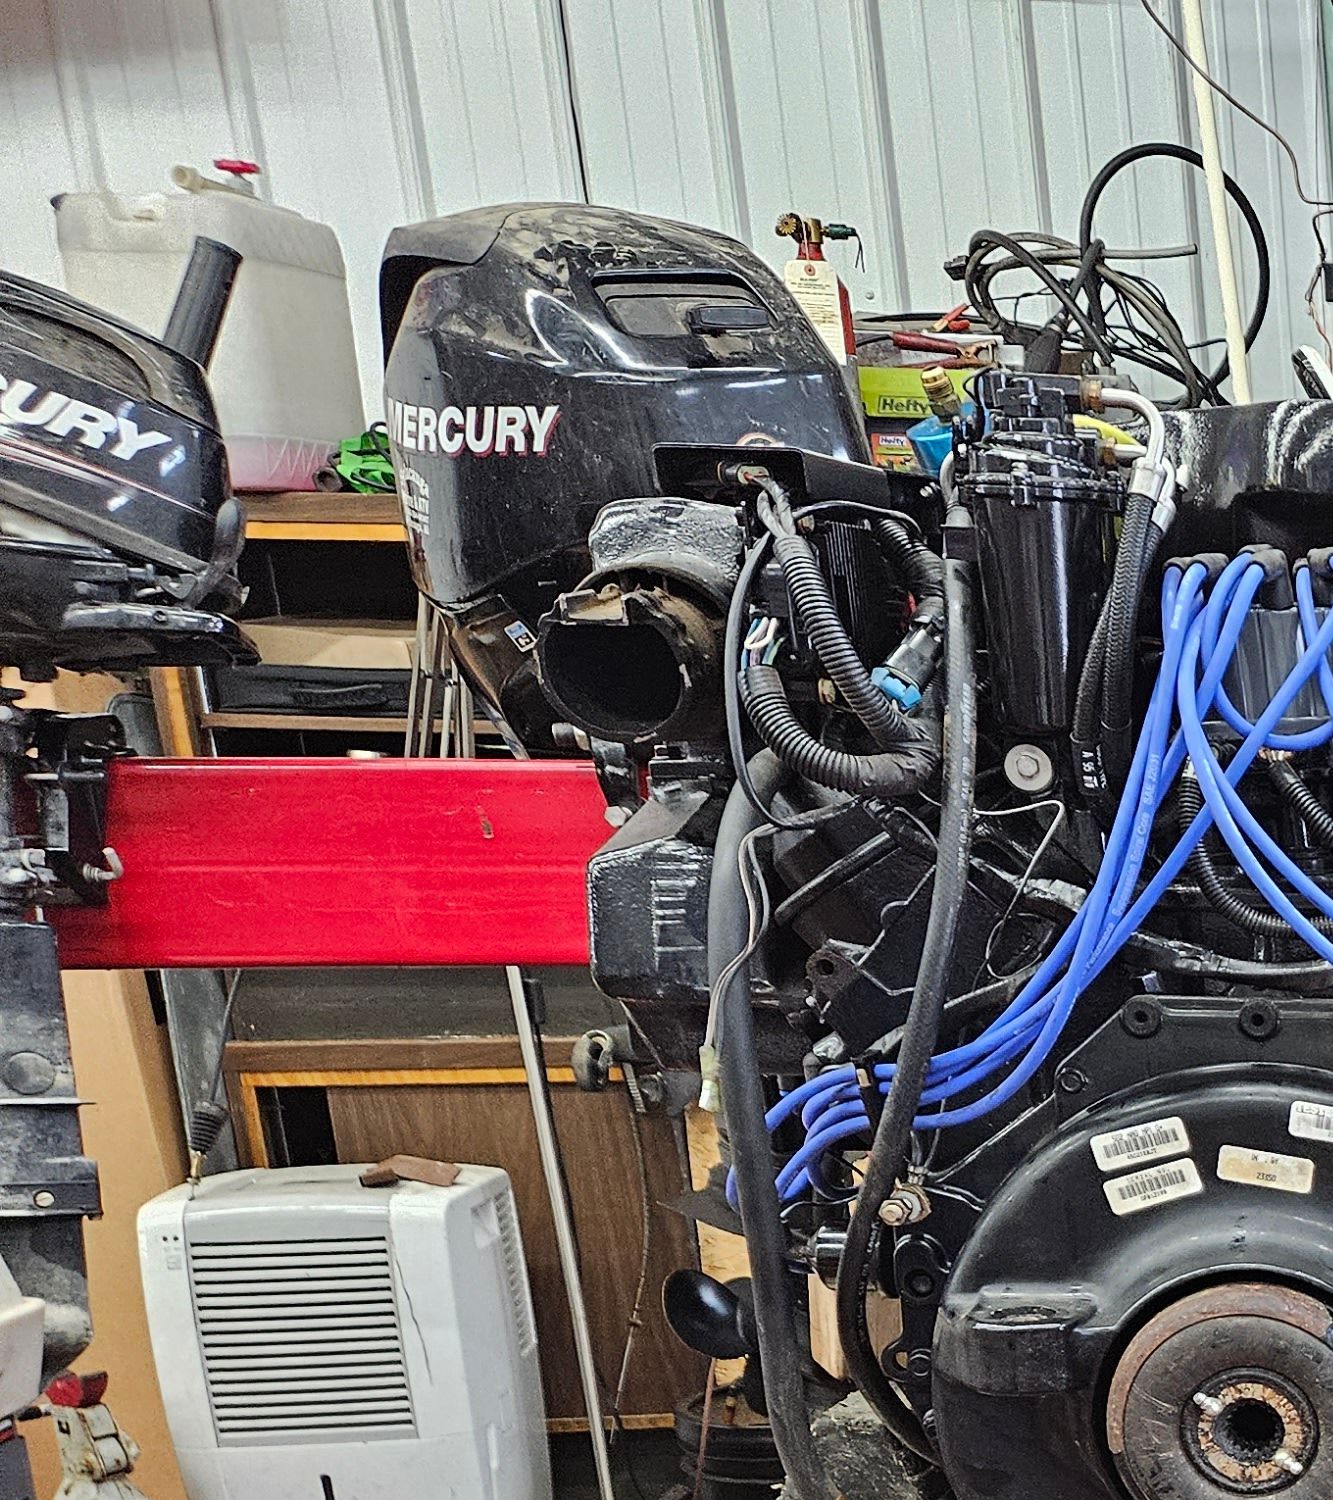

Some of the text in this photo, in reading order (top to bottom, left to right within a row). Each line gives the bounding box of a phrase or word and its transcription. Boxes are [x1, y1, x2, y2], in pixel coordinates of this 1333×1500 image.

[0, 375, 172, 460] URY
[388, 398, 561, 456] MERCURY
[882, 398, 928, 413] Hefty
